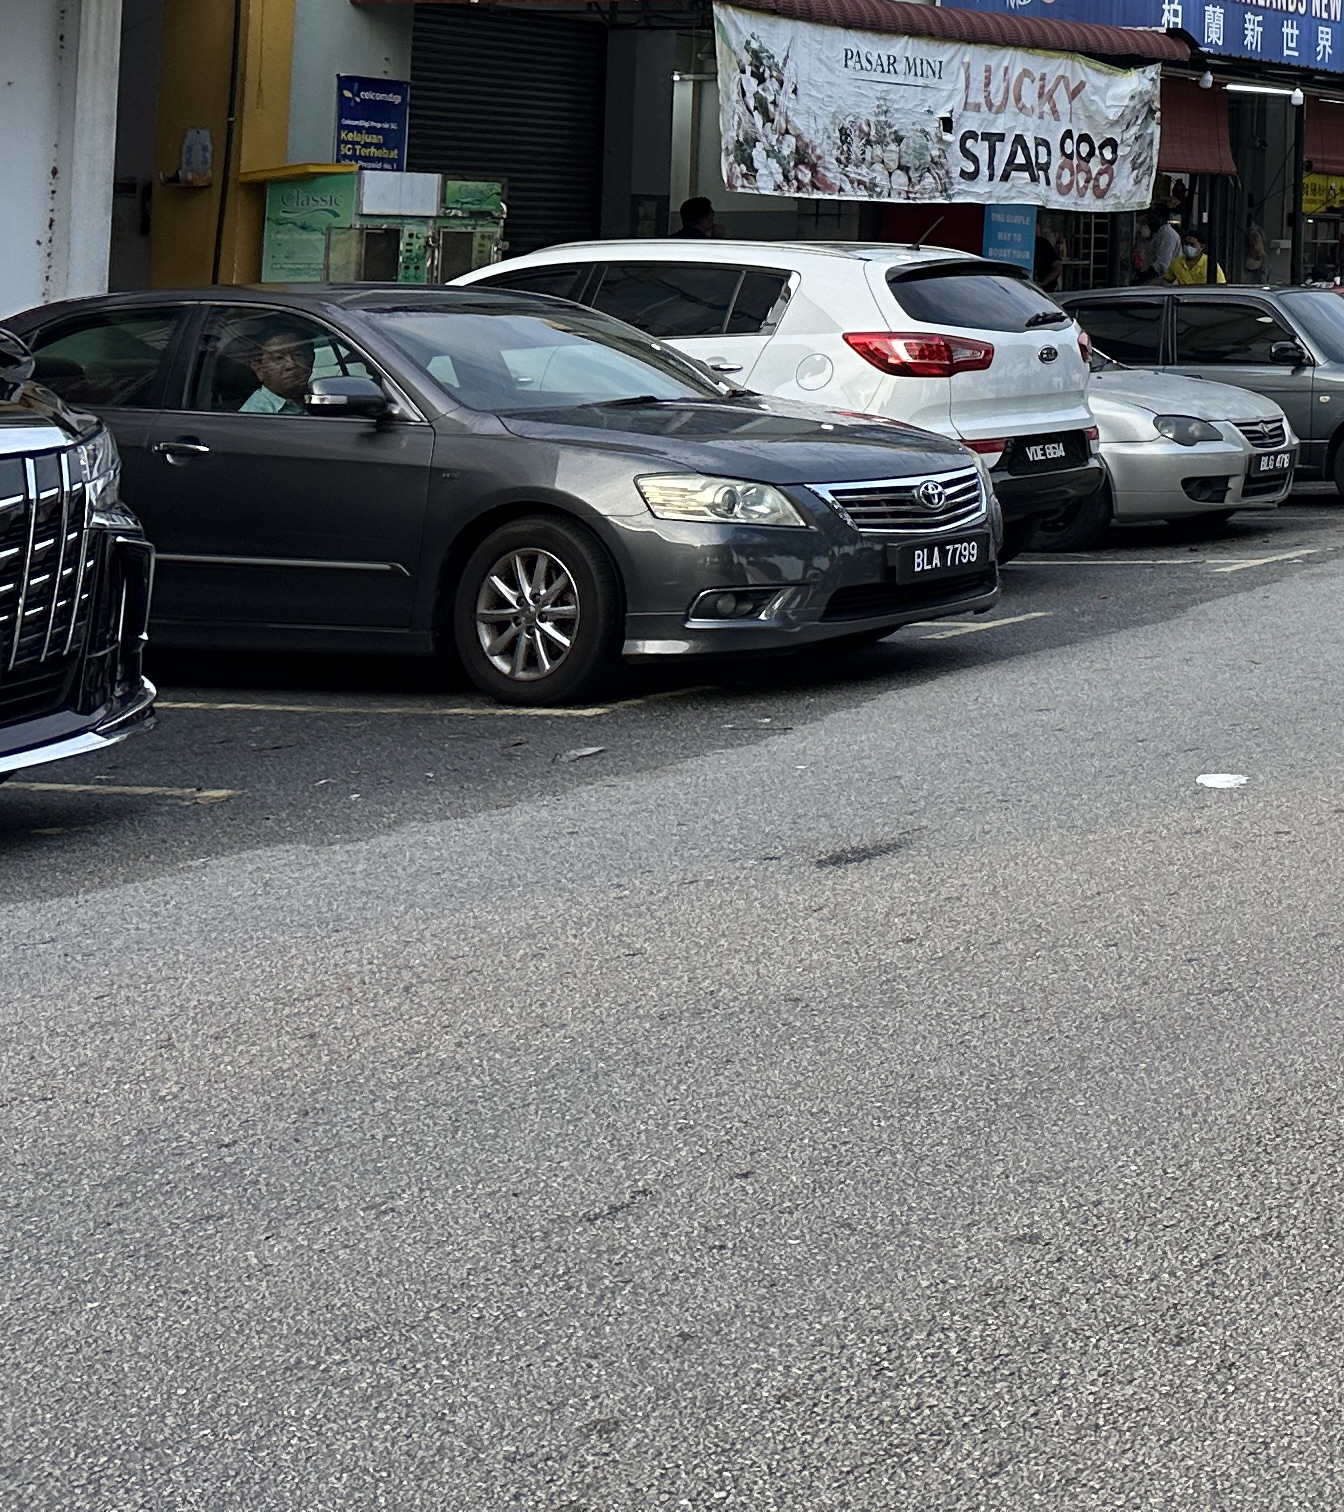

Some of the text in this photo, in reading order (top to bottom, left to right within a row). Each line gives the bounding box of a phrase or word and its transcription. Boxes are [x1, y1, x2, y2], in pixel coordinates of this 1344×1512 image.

[843, 48, 944, 81] PASAR MINI
[961, 61, 1087, 122] LUCKY
[340, 130, 383, 145] Kelajuan
[340, 144, 399, 159] 5G Terhebat
[280, 188, 344, 208] Classic
[1012, 233, 1022, 243] TO
[988, 247, 1012, 258] BOOST
[1025, 444, 1046, 462] VDE
[1259, 455, 1275, 471] BLG
[914, 542, 978, 572] BLA 7799
